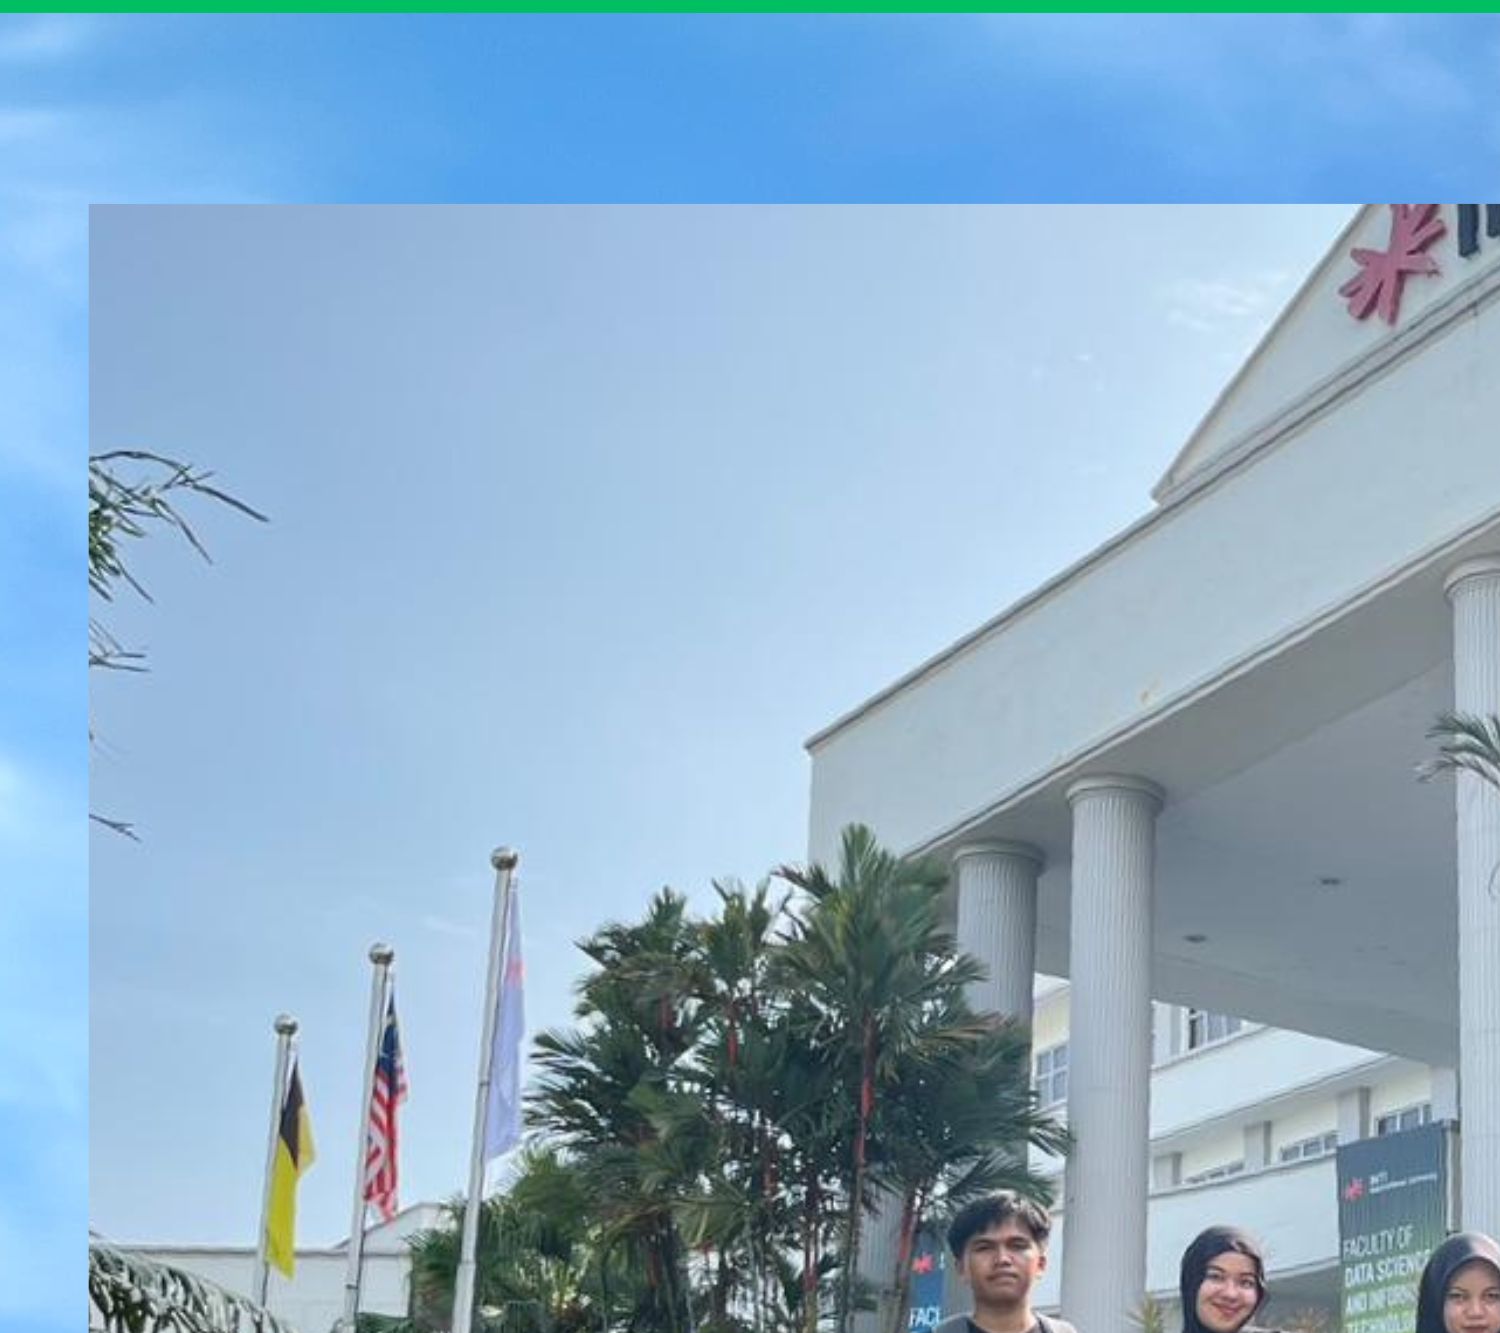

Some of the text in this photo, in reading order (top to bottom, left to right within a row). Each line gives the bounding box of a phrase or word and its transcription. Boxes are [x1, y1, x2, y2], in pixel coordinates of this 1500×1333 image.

[1343, 1223, 1414, 1259] FACULTY OF
[1345, 1262, 1375, 1288] DATA
